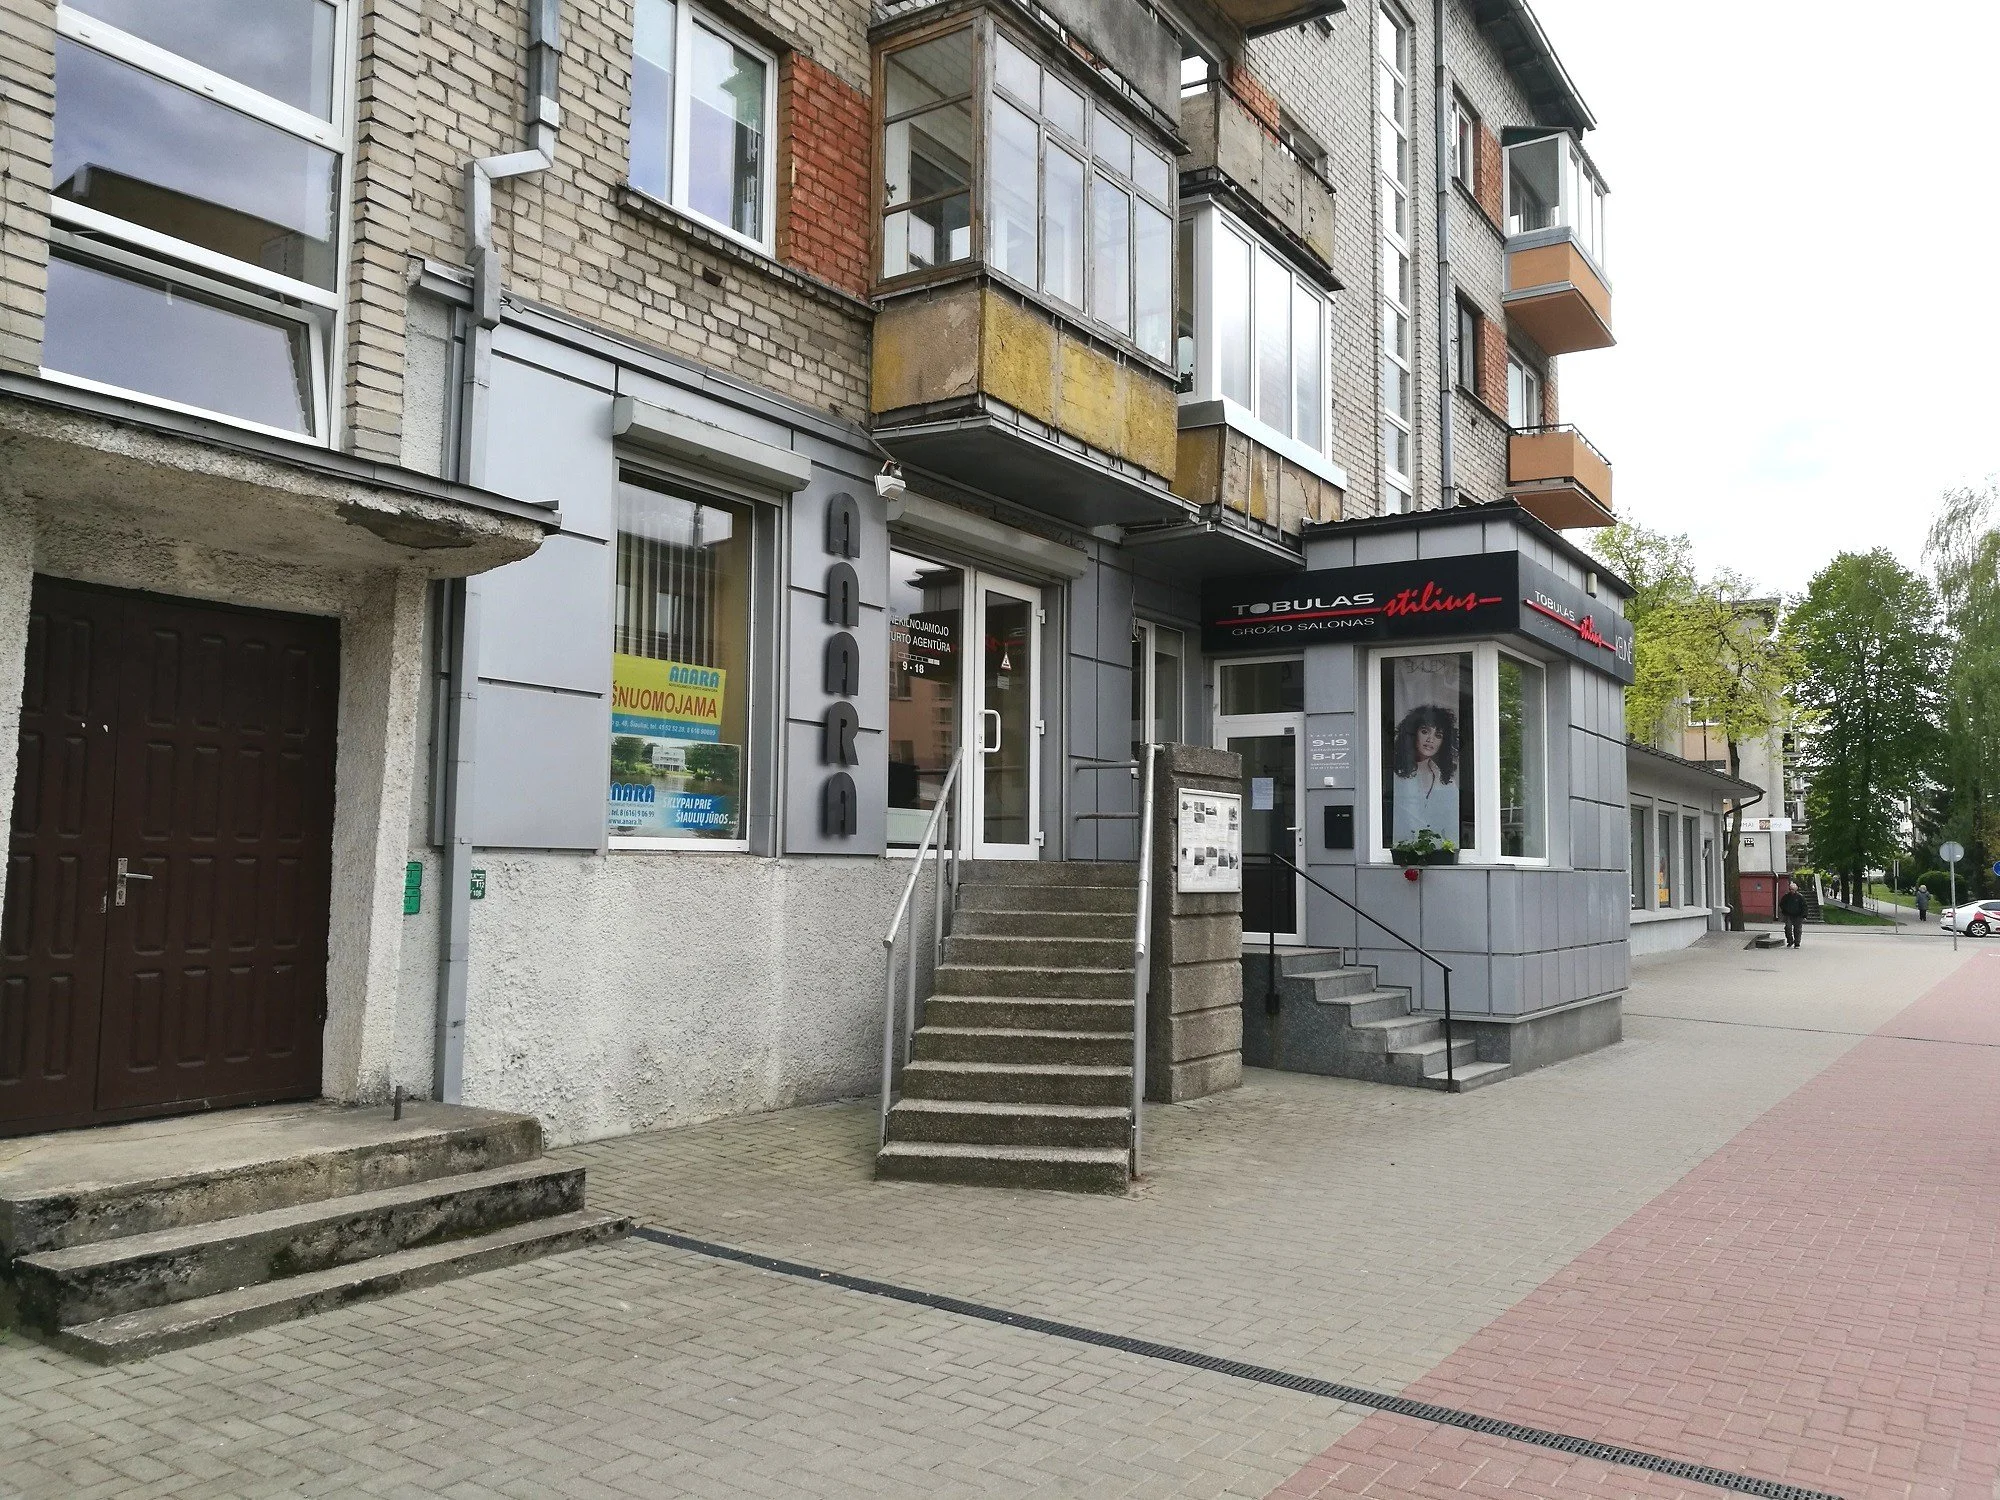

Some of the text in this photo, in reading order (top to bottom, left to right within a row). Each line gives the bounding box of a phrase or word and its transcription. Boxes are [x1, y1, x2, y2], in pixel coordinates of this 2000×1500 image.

[1232, 581, 1478, 617] TOBULAS stilius
[1534, 590, 1576, 621] TOBULAS
[1232, 617, 1375, 636] GROŽIO SALONAS
[912, 636, 951, 652] AGENTŪRA
[902, 660, 908, 671] 9
[914, 663, 924, 674] 18
[669, 665, 719, 688] ANARA
[1312, 738, 1348, 747] 9-19
[1312, 752, 1347, 761] 8-17
[609, 782, 655, 802] NARA
[663, 796, 694, 809] SKLYPAI
[694, 798, 712, 810] PRIE
[675, 809, 704, 826] ŠIAULIŲ
